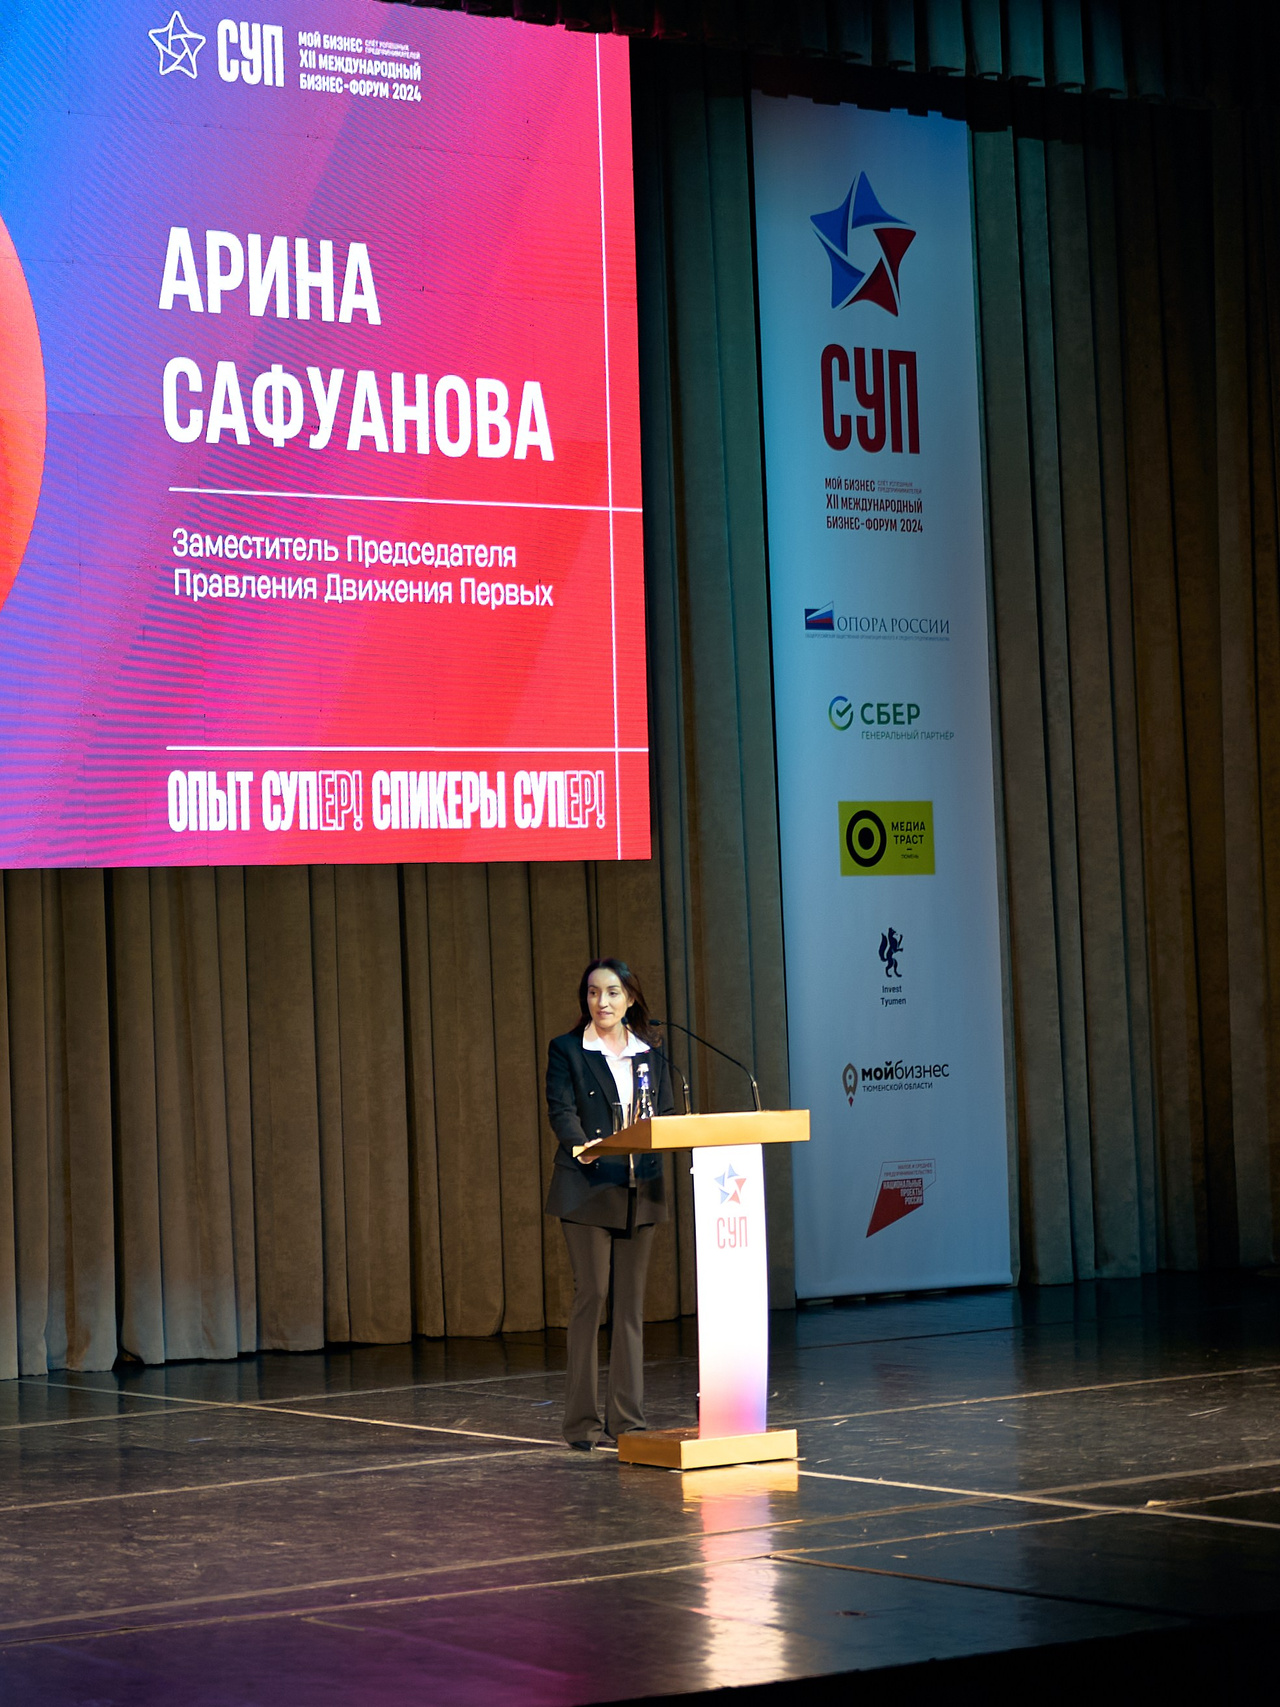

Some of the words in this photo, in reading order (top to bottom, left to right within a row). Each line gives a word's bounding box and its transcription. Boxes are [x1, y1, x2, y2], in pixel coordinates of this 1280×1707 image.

[217, 19, 284, 87] СУП
[298, 31, 321, 49] МОЙ
[322, 34, 363, 53] БИЗНЕС
[318, 54, 422, 81] МЕЖДУНАРОДНЫЙ
[299, 73, 389, 98] БИЗНЕС-ФОРУМ
[392, 82, 422, 102] 2024
[158, 226, 381, 326] АРИНА
[162, 356, 555, 461] САФУАНОВА
[821, 343, 920, 455] СУП
[824, 476, 843, 490] МОЙ
[844, 478, 876, 492] БИЗНЕС
[841, 496, 923, 514] МЕЖДУНАРОДНЫЙ
[826, 515, 898, 533] БИЗНЕС-ФОРУМ
[900, 518, 923, 533] 2024
[172, 528, 339, 562] Заместитель
[346, 536, 517, 567] Председателя
[174, 569, 317, 602] Правления
[324, 574, 453, 604] Движения
[460, 578, 554, 609] Первых
[837, 616, 888, 633] ОПОРА
[891, 618, 950, 634] РОССИИ
[860, 702, 921, 726] СБЕР
[861, 730, 919, 741] ГЕНЕРАЛЬНЫЙ
[921, 731, 955, 741] ПАРТНЁР
[167, 769, 254, 832] ОПЫТ
[261, 769, 363, 832] СУПЕР!
[371, 769, 507, 830] СПИКЕРЫ
[513, 769, 606, 830] СУПЕР!
[891, 821, 926, 832] МЕДИА
[894, 834, 924, 845] ТРАСТ
[882, 985, 902, 994] Invest
[880, 997, 906, 1007] Tyumen
[861, 1060, 950, 1082] мойбизнес
[862, 1083, 903, 1093] ТЮМЕНСКОЙ
[904, 1082, 934, 1091] ОБЛАСТИ
[716, 1217, 749, 1249] СУП
